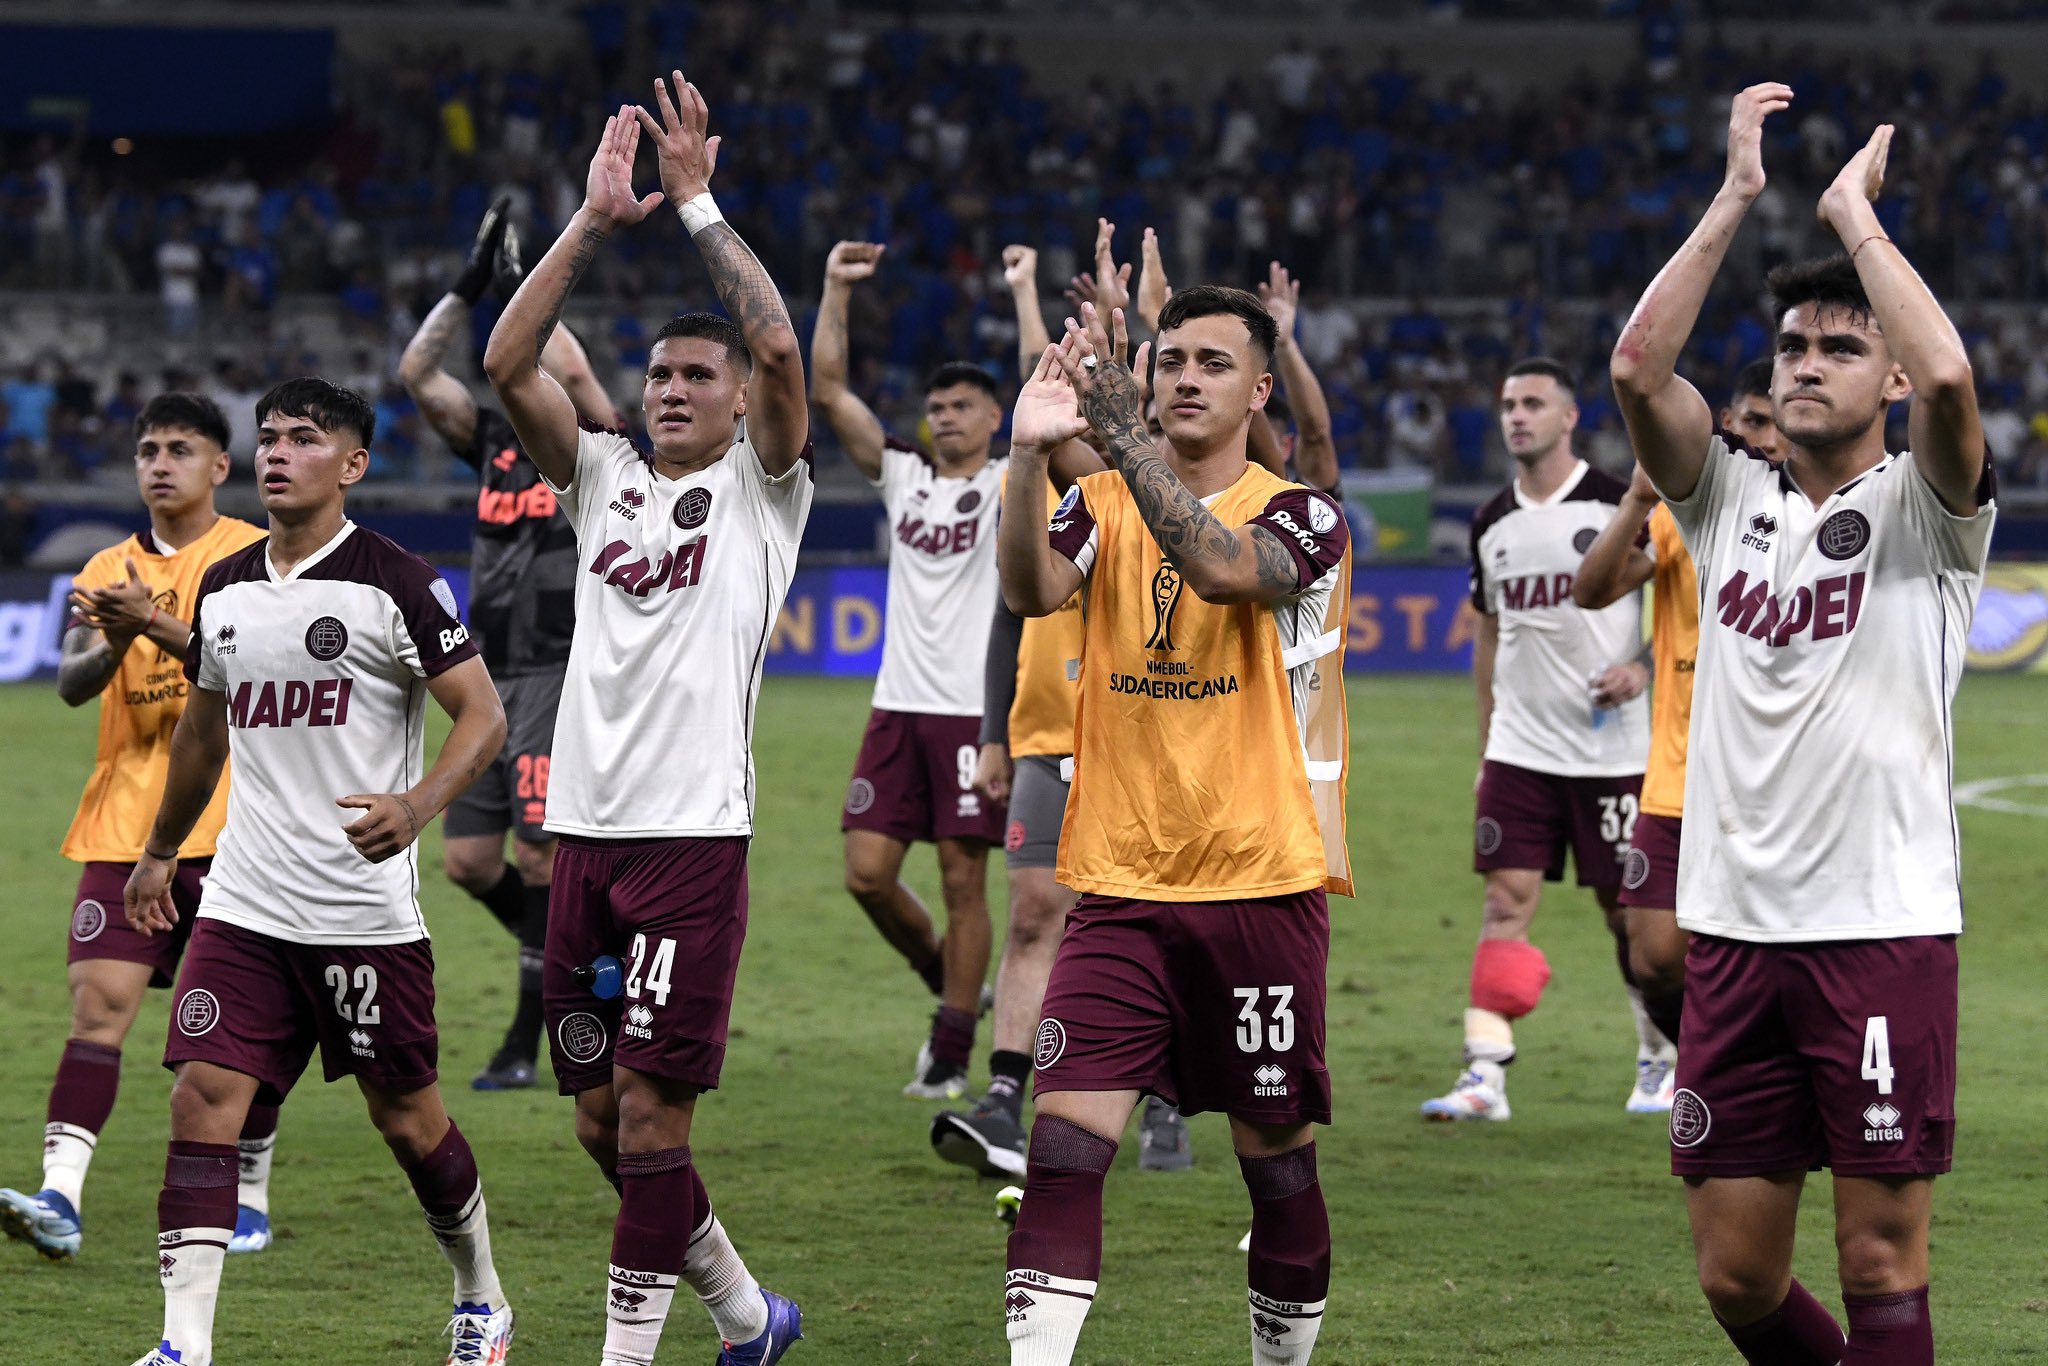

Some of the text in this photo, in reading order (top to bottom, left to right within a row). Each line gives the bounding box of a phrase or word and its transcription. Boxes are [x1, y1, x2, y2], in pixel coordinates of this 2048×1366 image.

[609, 500, 637, 521] errea
[1741, 532, 1771, 553] errea
[1717, 569, 1866, 648] MAPEI
[217, 644, 237, 656] errea
[226, 678, 353, 728] MAPEI
[957, 744, 978, 790] 9
[1598, 793, 1639, 842] 32
[626, 932, 677, 1006] 24
[324, 964, 381, 1025] 22
[1233, 984, 1295, 1053] 33
[625, 1023, 653, 1040] errea
[1861, 1015, 1895, 1095] 4
[1254, 1084, 1288, 1097] errea
[1864, 1125, 1904, 1143] errea
[612, 1266, 659, 1284] LANUS
[609, 1299, 639, 1313] errea
[1250, 1289, 1304, 1314] LANUS
[1253, 1326, 1281, 1347] errea
